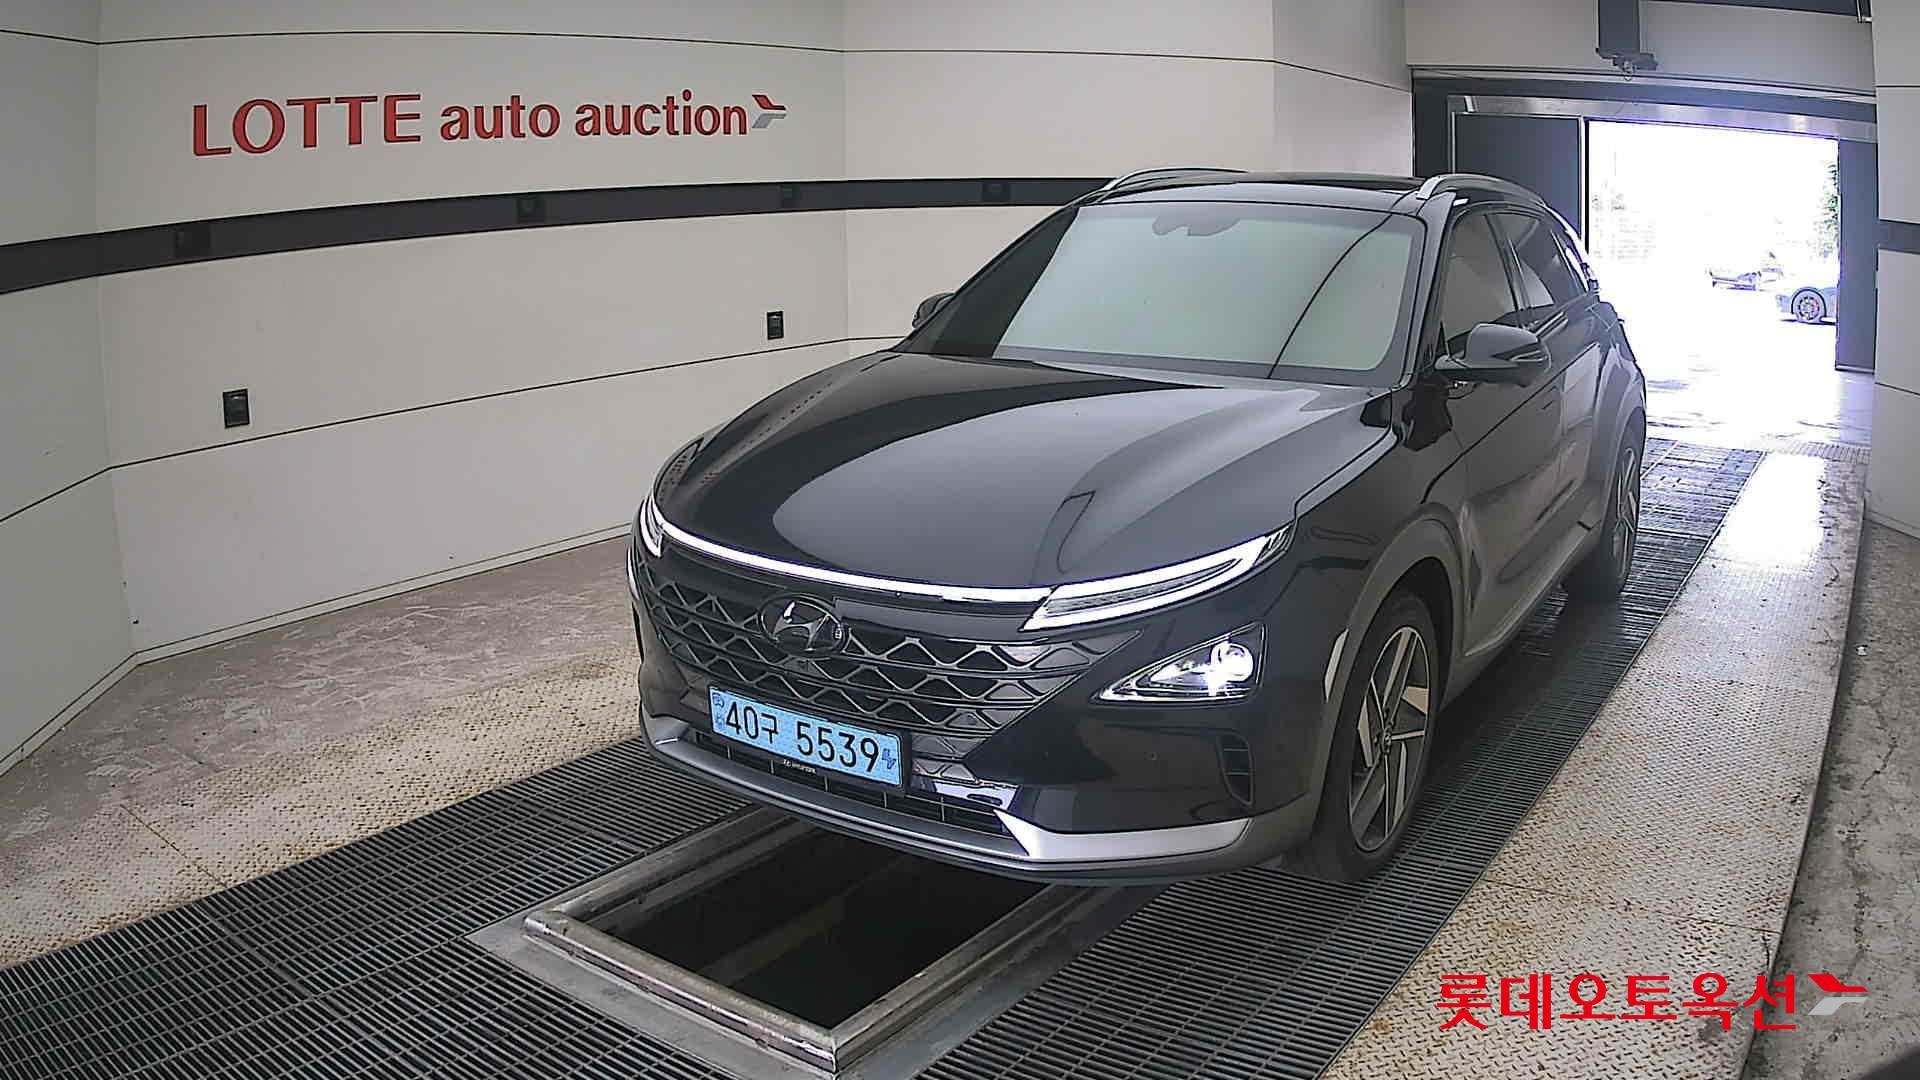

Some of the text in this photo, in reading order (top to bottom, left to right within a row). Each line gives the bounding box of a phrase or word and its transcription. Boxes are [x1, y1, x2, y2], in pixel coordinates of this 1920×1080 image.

[193, 89, 748, 156] LOTTE auto auction
[725, 701, 879, 772] 40구 5539
